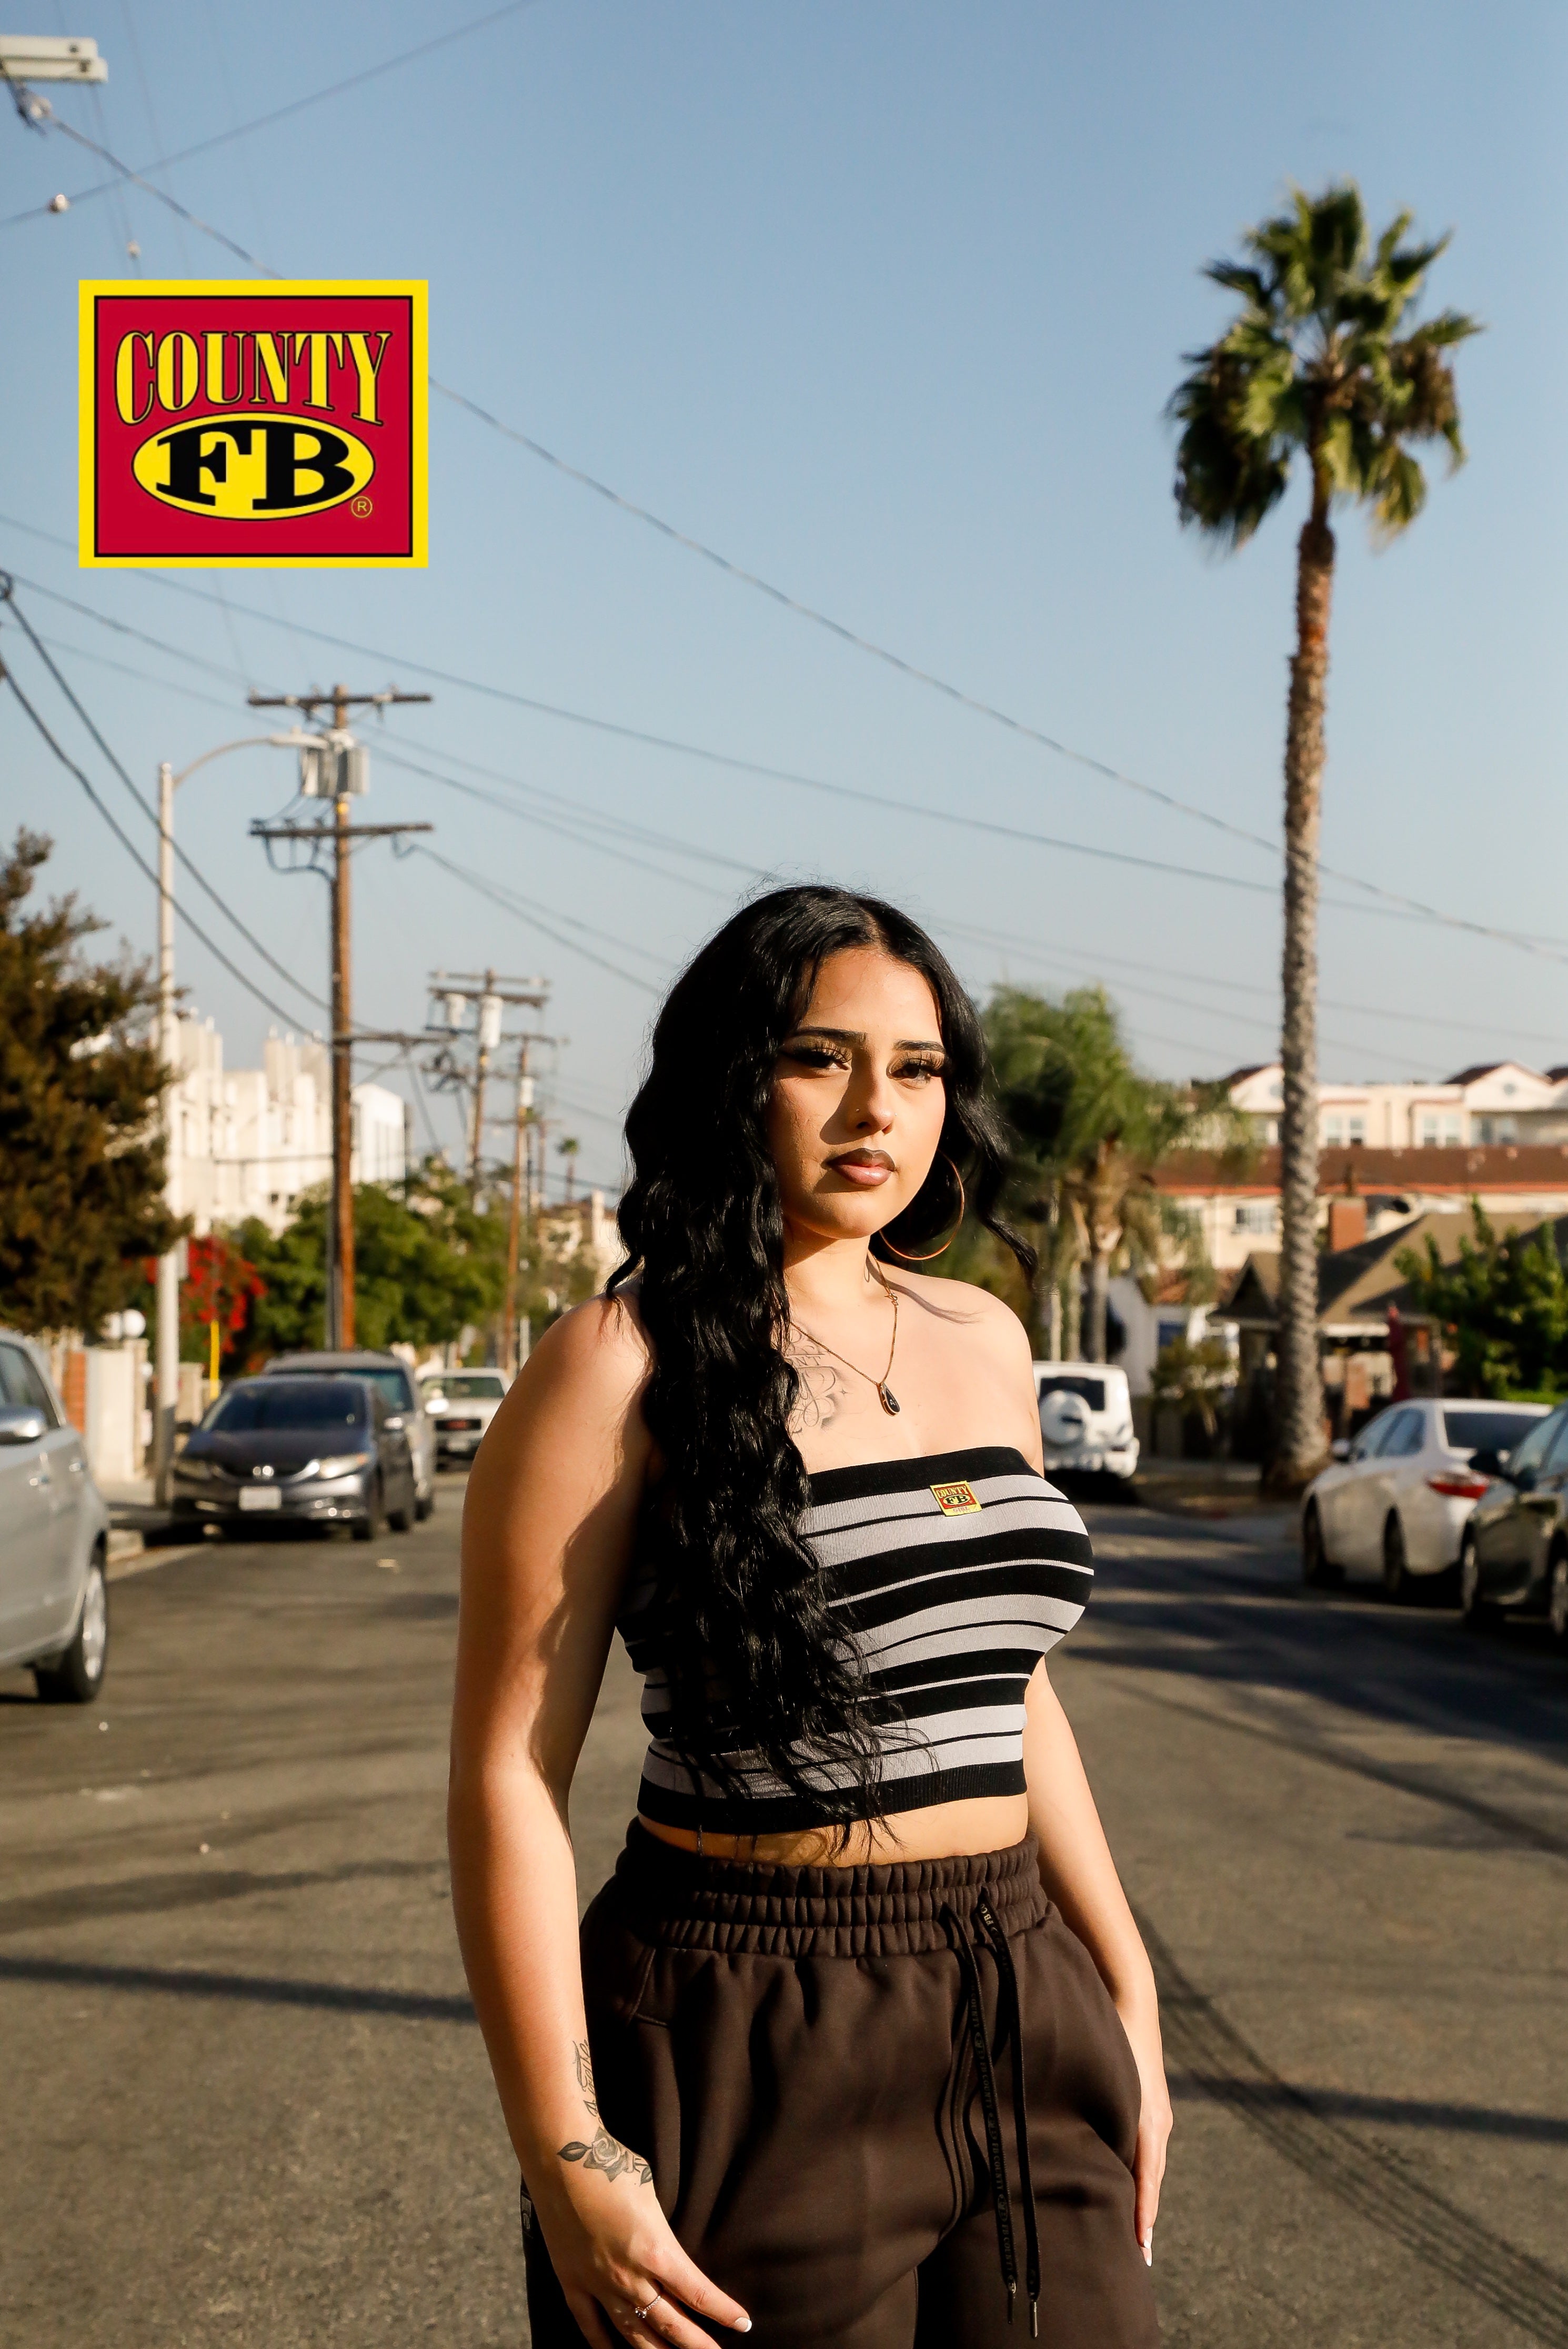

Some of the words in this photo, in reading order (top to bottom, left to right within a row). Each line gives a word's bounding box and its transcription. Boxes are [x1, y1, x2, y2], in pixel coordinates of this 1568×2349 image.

[936, 1485, 969, 1499] COUNTY
[944, 1495, 968, 1504] FB
[982, 2074, 994, 2110] COUNTY
[993, 2155, 1004, 2191] COUNTY
[1003, 2236, 1014, 2271] COUNTY
